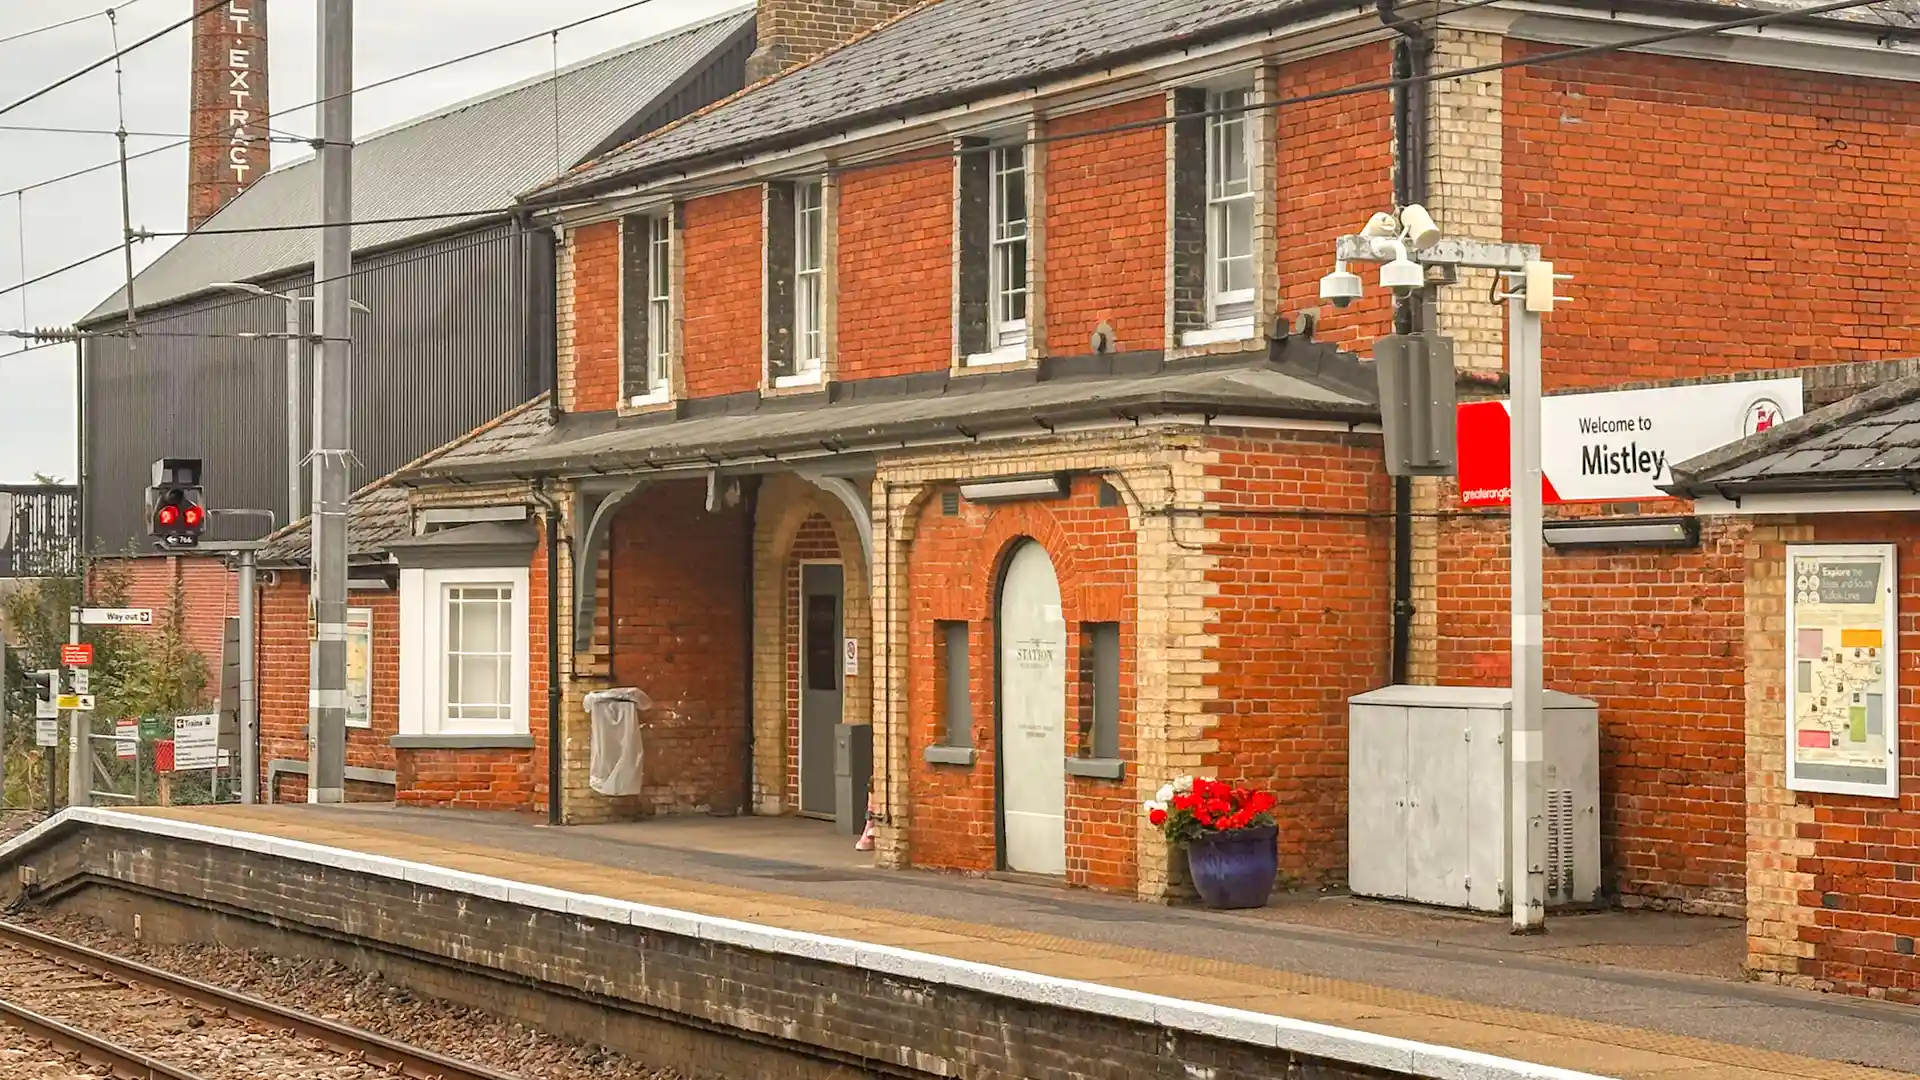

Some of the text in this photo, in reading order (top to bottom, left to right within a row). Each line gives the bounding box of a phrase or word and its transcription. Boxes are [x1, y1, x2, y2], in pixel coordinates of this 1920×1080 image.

[1579, 416, 1652, 434] Welcome to
[1581, 442, 1665, 480] Mistley
[1822, 566, 1851, 578] Explore
[106, 612, 138, 622] Way out
[1017, 648, 1053, 661] STATION
[185, 719, 203, 727] Trains
